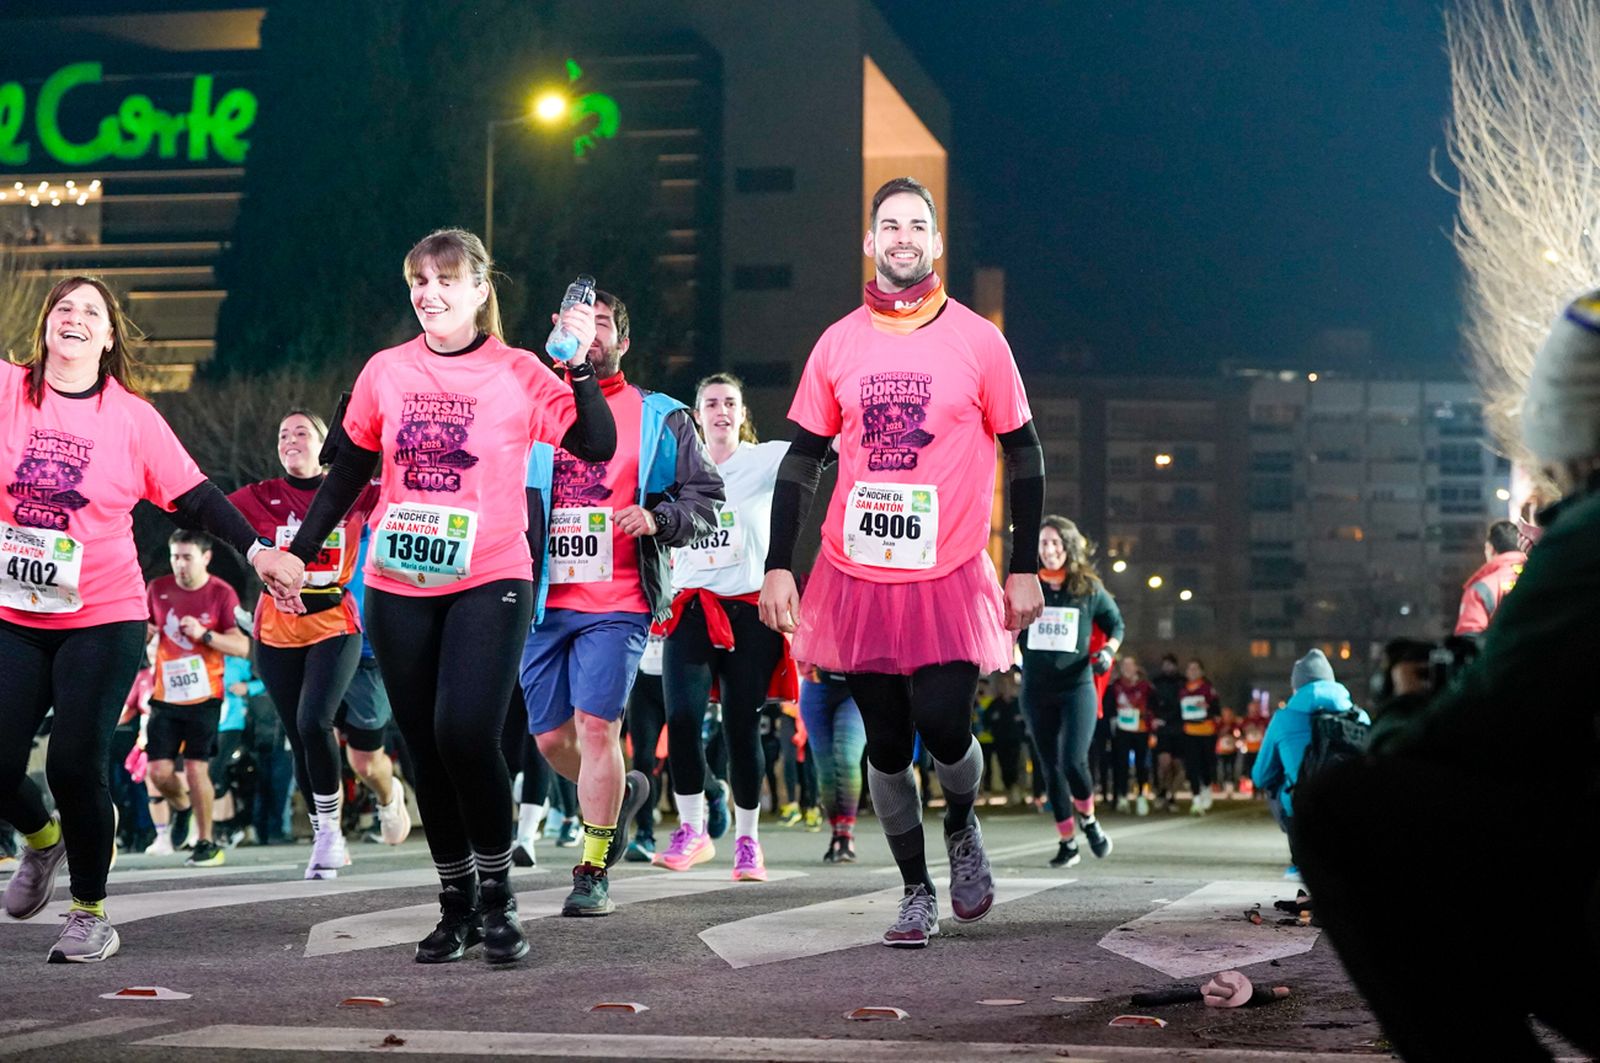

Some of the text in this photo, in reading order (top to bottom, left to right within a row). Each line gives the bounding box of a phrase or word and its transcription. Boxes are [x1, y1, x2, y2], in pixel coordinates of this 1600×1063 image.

[0, 60, 258, 167] l Corte
[873, 372, 932, 384] CONSEGUIDO
[862, 380, 930, 399] DORSAL
[403, 400, 474, 419] DORSAL
[872, 396, 891, 405] SAN
[413, 413, 433, 422] SAN
[870, 453, 915, 469] 500€
[407, 472, 458, 491] 500€
[866, 490, 892, 501] NOCHE
[893, 492, 904, 502] DE
[855, 499, 873, 510] SAN
[873, 501, 904, 513] ANTÓN
[16, 506, 67, 529] 500€
[397, 511, 440, 525] NOCHE DE
[859, 511, 922, 540] 4906
[385, 520, 406, 531] SAN
[406, 522, 439, 536] ANTÓN
[386, 532, 461, 567] 13907
[549, 535, 598, 558] 4690
[7, 555, 59, 587] 4702
